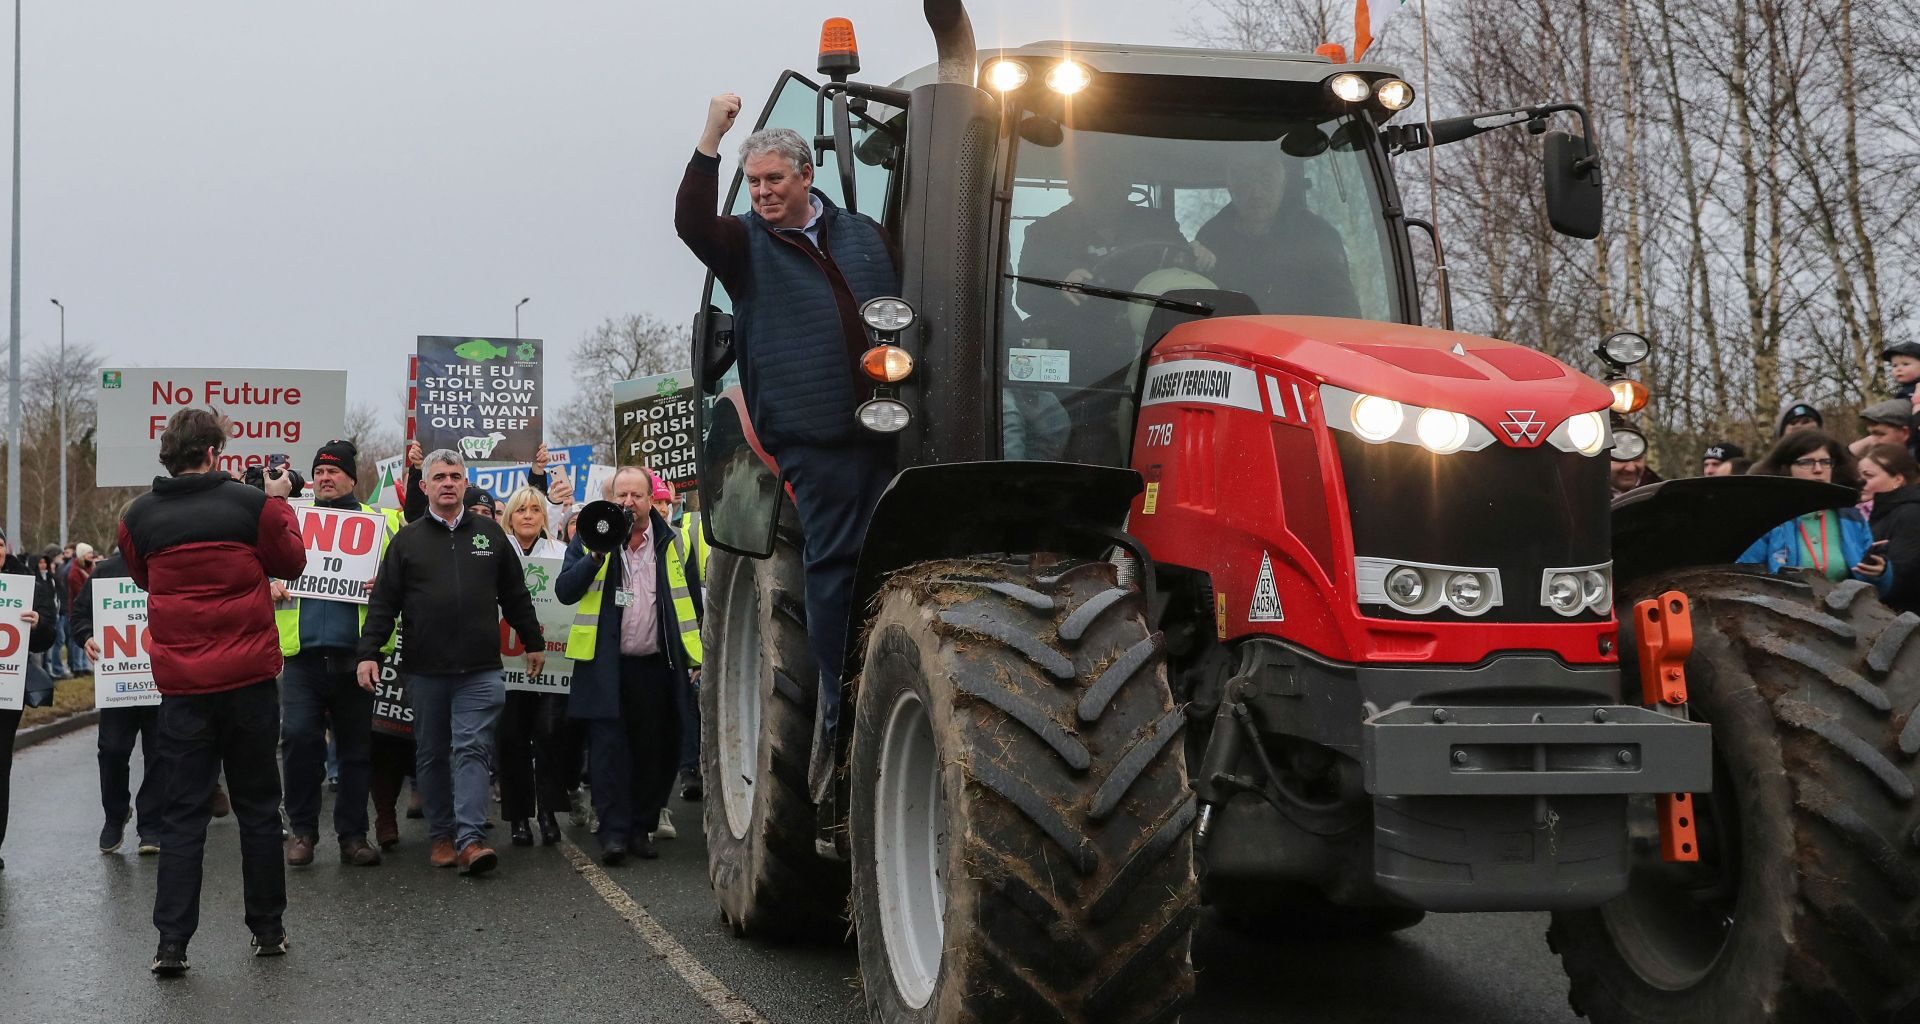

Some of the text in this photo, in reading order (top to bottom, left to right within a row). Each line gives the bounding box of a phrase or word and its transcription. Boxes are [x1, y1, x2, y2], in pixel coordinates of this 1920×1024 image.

[445, 364, 514, 377] THE EU
[425, 377, 535, 391] STOLE OUR
[1149, 370, 1232, 400] MASSEY FERGUSON
[152, 381, 302, 405] No Future
[429, 390, 532, 403] FISH NOW
[421, 403, 539, 417] THEY WANT
[226, 419, 301, 443] oung
[431, 417, 529, 430] OUR BEEF
[643, 415, 695, 438] IRISH
[1146, 423, 1173, 447] 7718
[463, 436, 495, 451] Beef
[630, 433, 688, 456] FOOD
[644, 446, 696, 468] IRISH
[653, 462, 697, 481] RMER
[302, 512, 376, 556] NO
[323, 557, 343, 572] TO
[119, 582, 145, 594] Iri
[1260, 578, 1270, 594] 03
[103, 598, 146, 610] Farm
[1256, 596, 1276, 612] A03N
[101, 661, 150, 672] to Merc
[528, 674, 557, 687] SELL
[105, 694, 138, 703] Supporting
